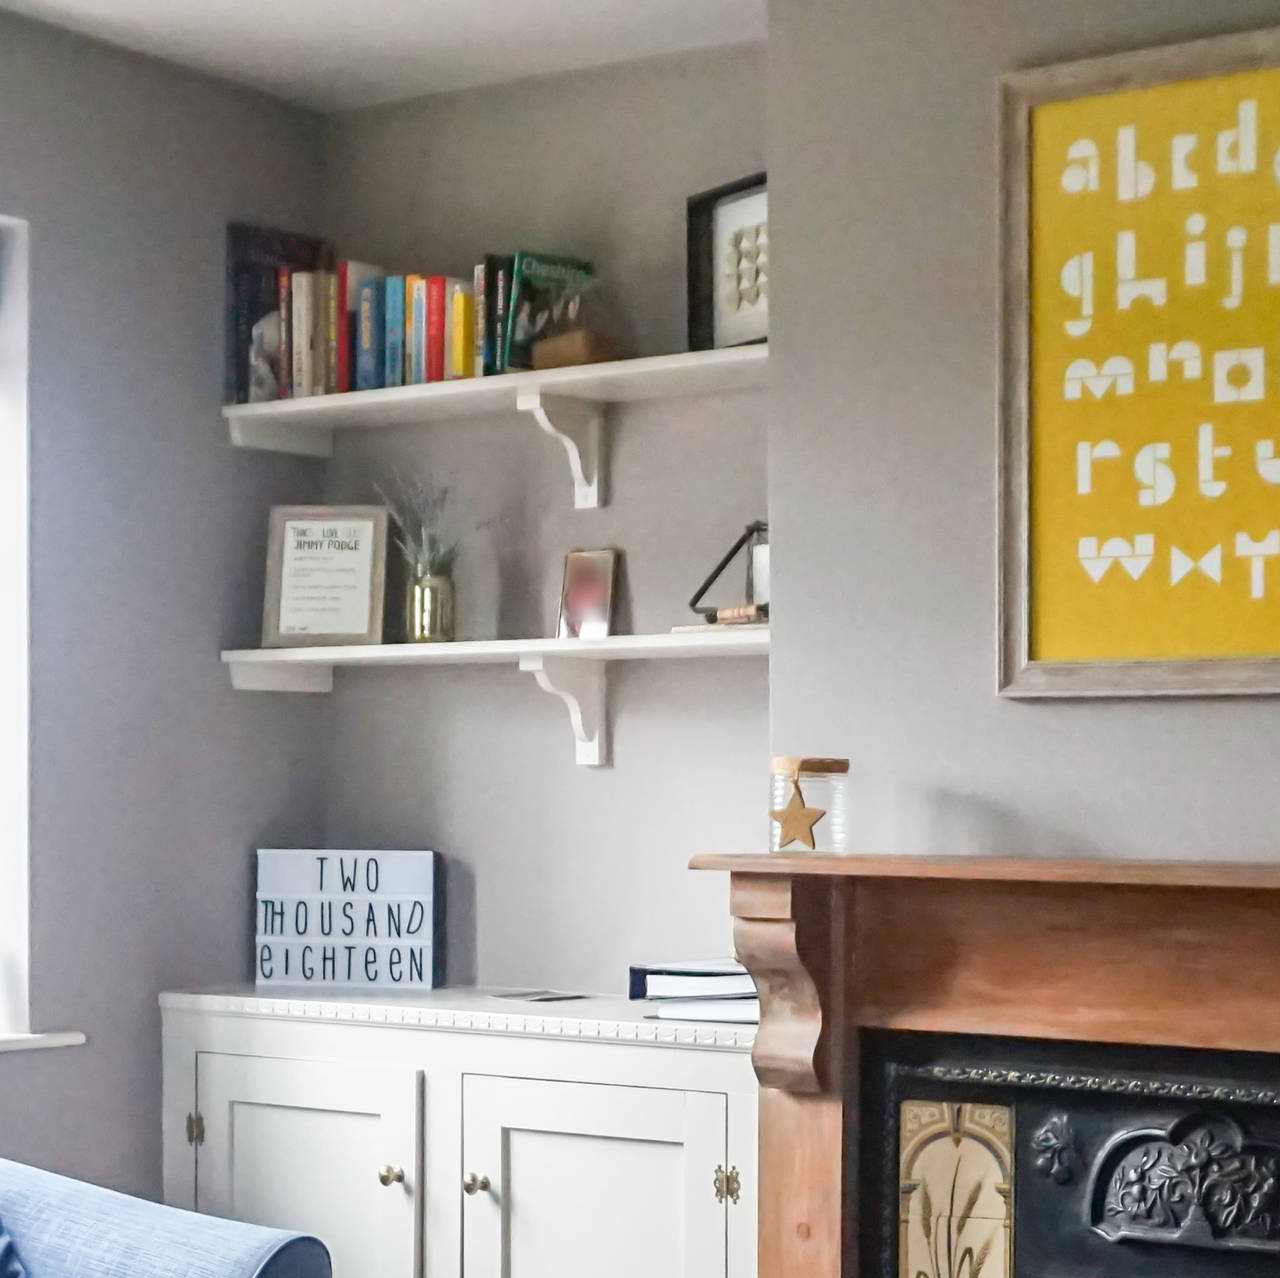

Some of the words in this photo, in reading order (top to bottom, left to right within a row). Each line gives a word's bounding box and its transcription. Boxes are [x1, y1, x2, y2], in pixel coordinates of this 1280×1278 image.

[294, 539, 324, 551] JIMMY
[316, 857, 379, 892] TWO
[261, 900, 424, 938] THOUSAND
